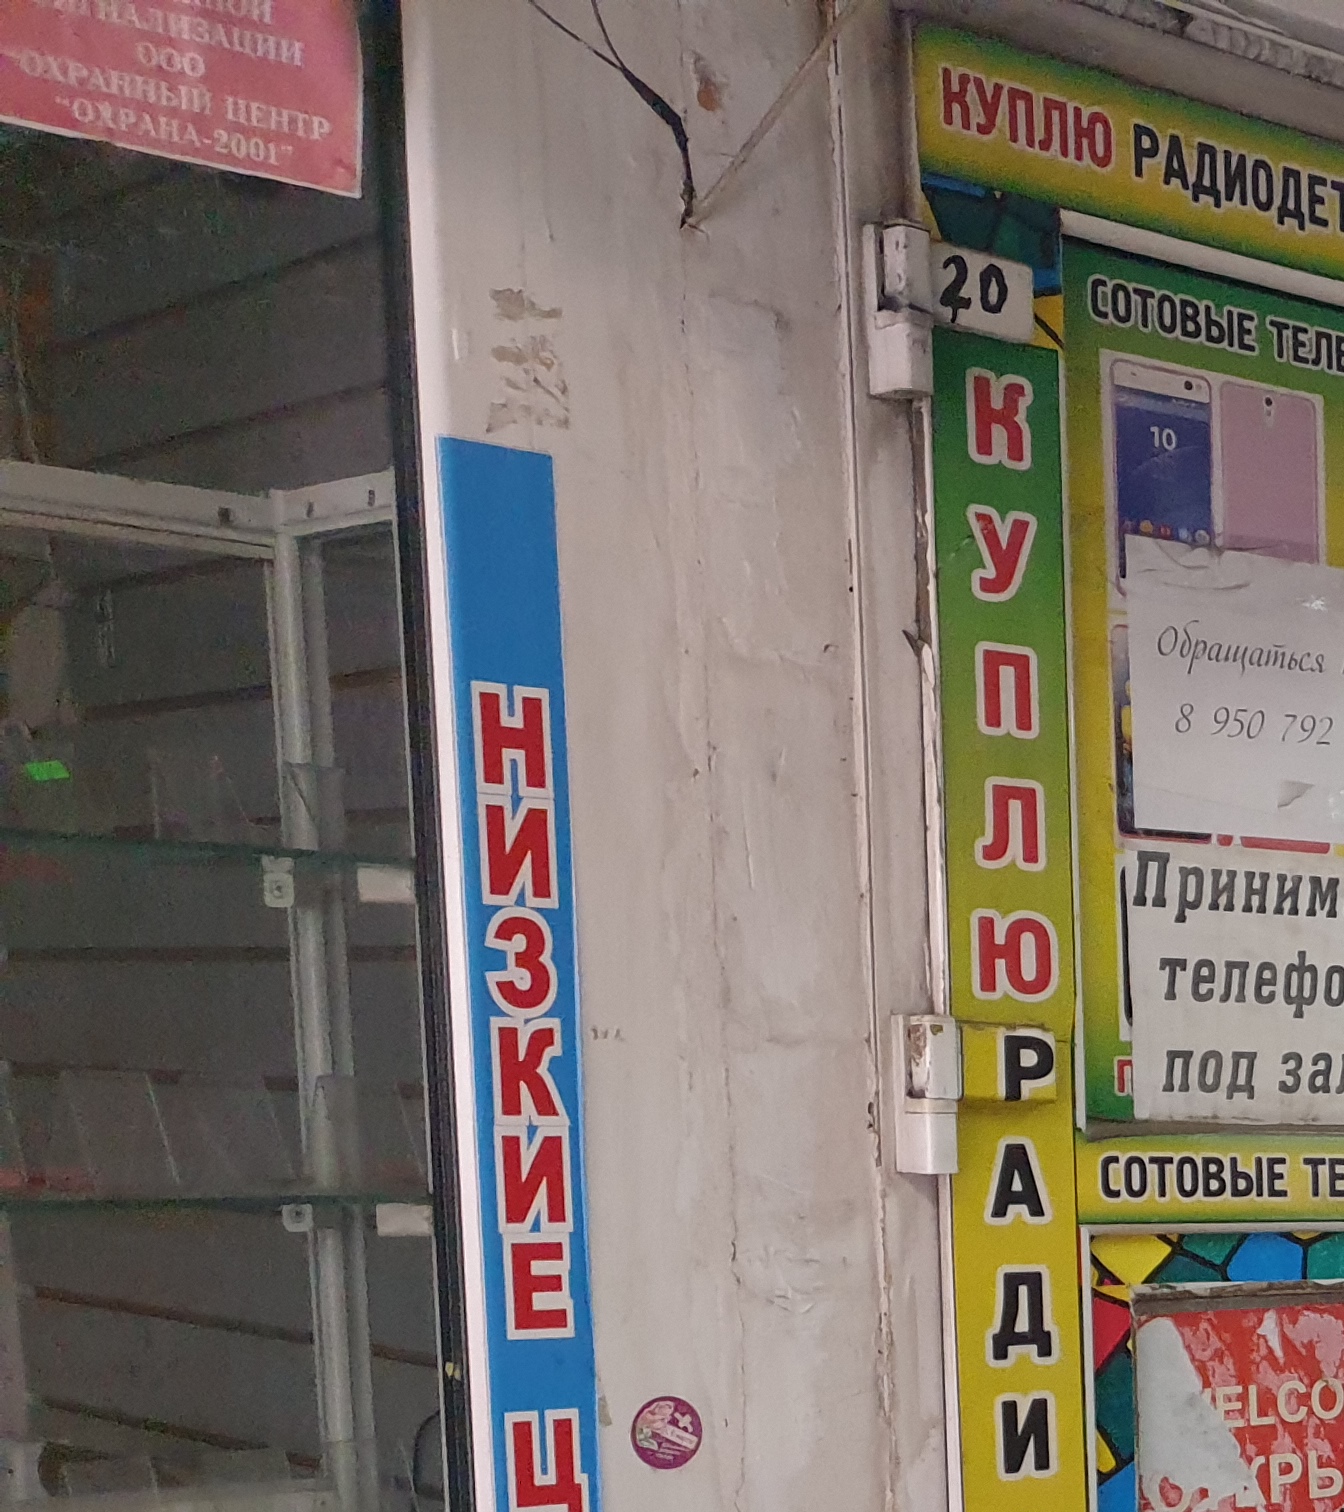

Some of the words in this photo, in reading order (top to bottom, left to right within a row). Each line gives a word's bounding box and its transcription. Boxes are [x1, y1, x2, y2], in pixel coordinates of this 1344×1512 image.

[136, 42, 205, 77] ООО
[225, 95, 331, 140] ЦЕНТР
[941, 66, 1113, 169] КУПЛЮ
[940, 255, 1009, 323] 20
[1090, 278, 1256, 351] СОТОВЫЕ
[1149, 425, 1178, 451] 10
[1156, 620, 1326, 674] Обращаться
[971, 373, 1052, 995] КУПЛЮ
[1174, 702, 1194, 733] 8
[1213, 706, 1265, 738] 950
[1280, 714, 1334, 745] 792
[474, 686, 571, 1335] НИЗКИЕ
[1162, 1049, 1256, 1100] под
[1101, 1155, 1287, 1198] СОТОВЫЕ
